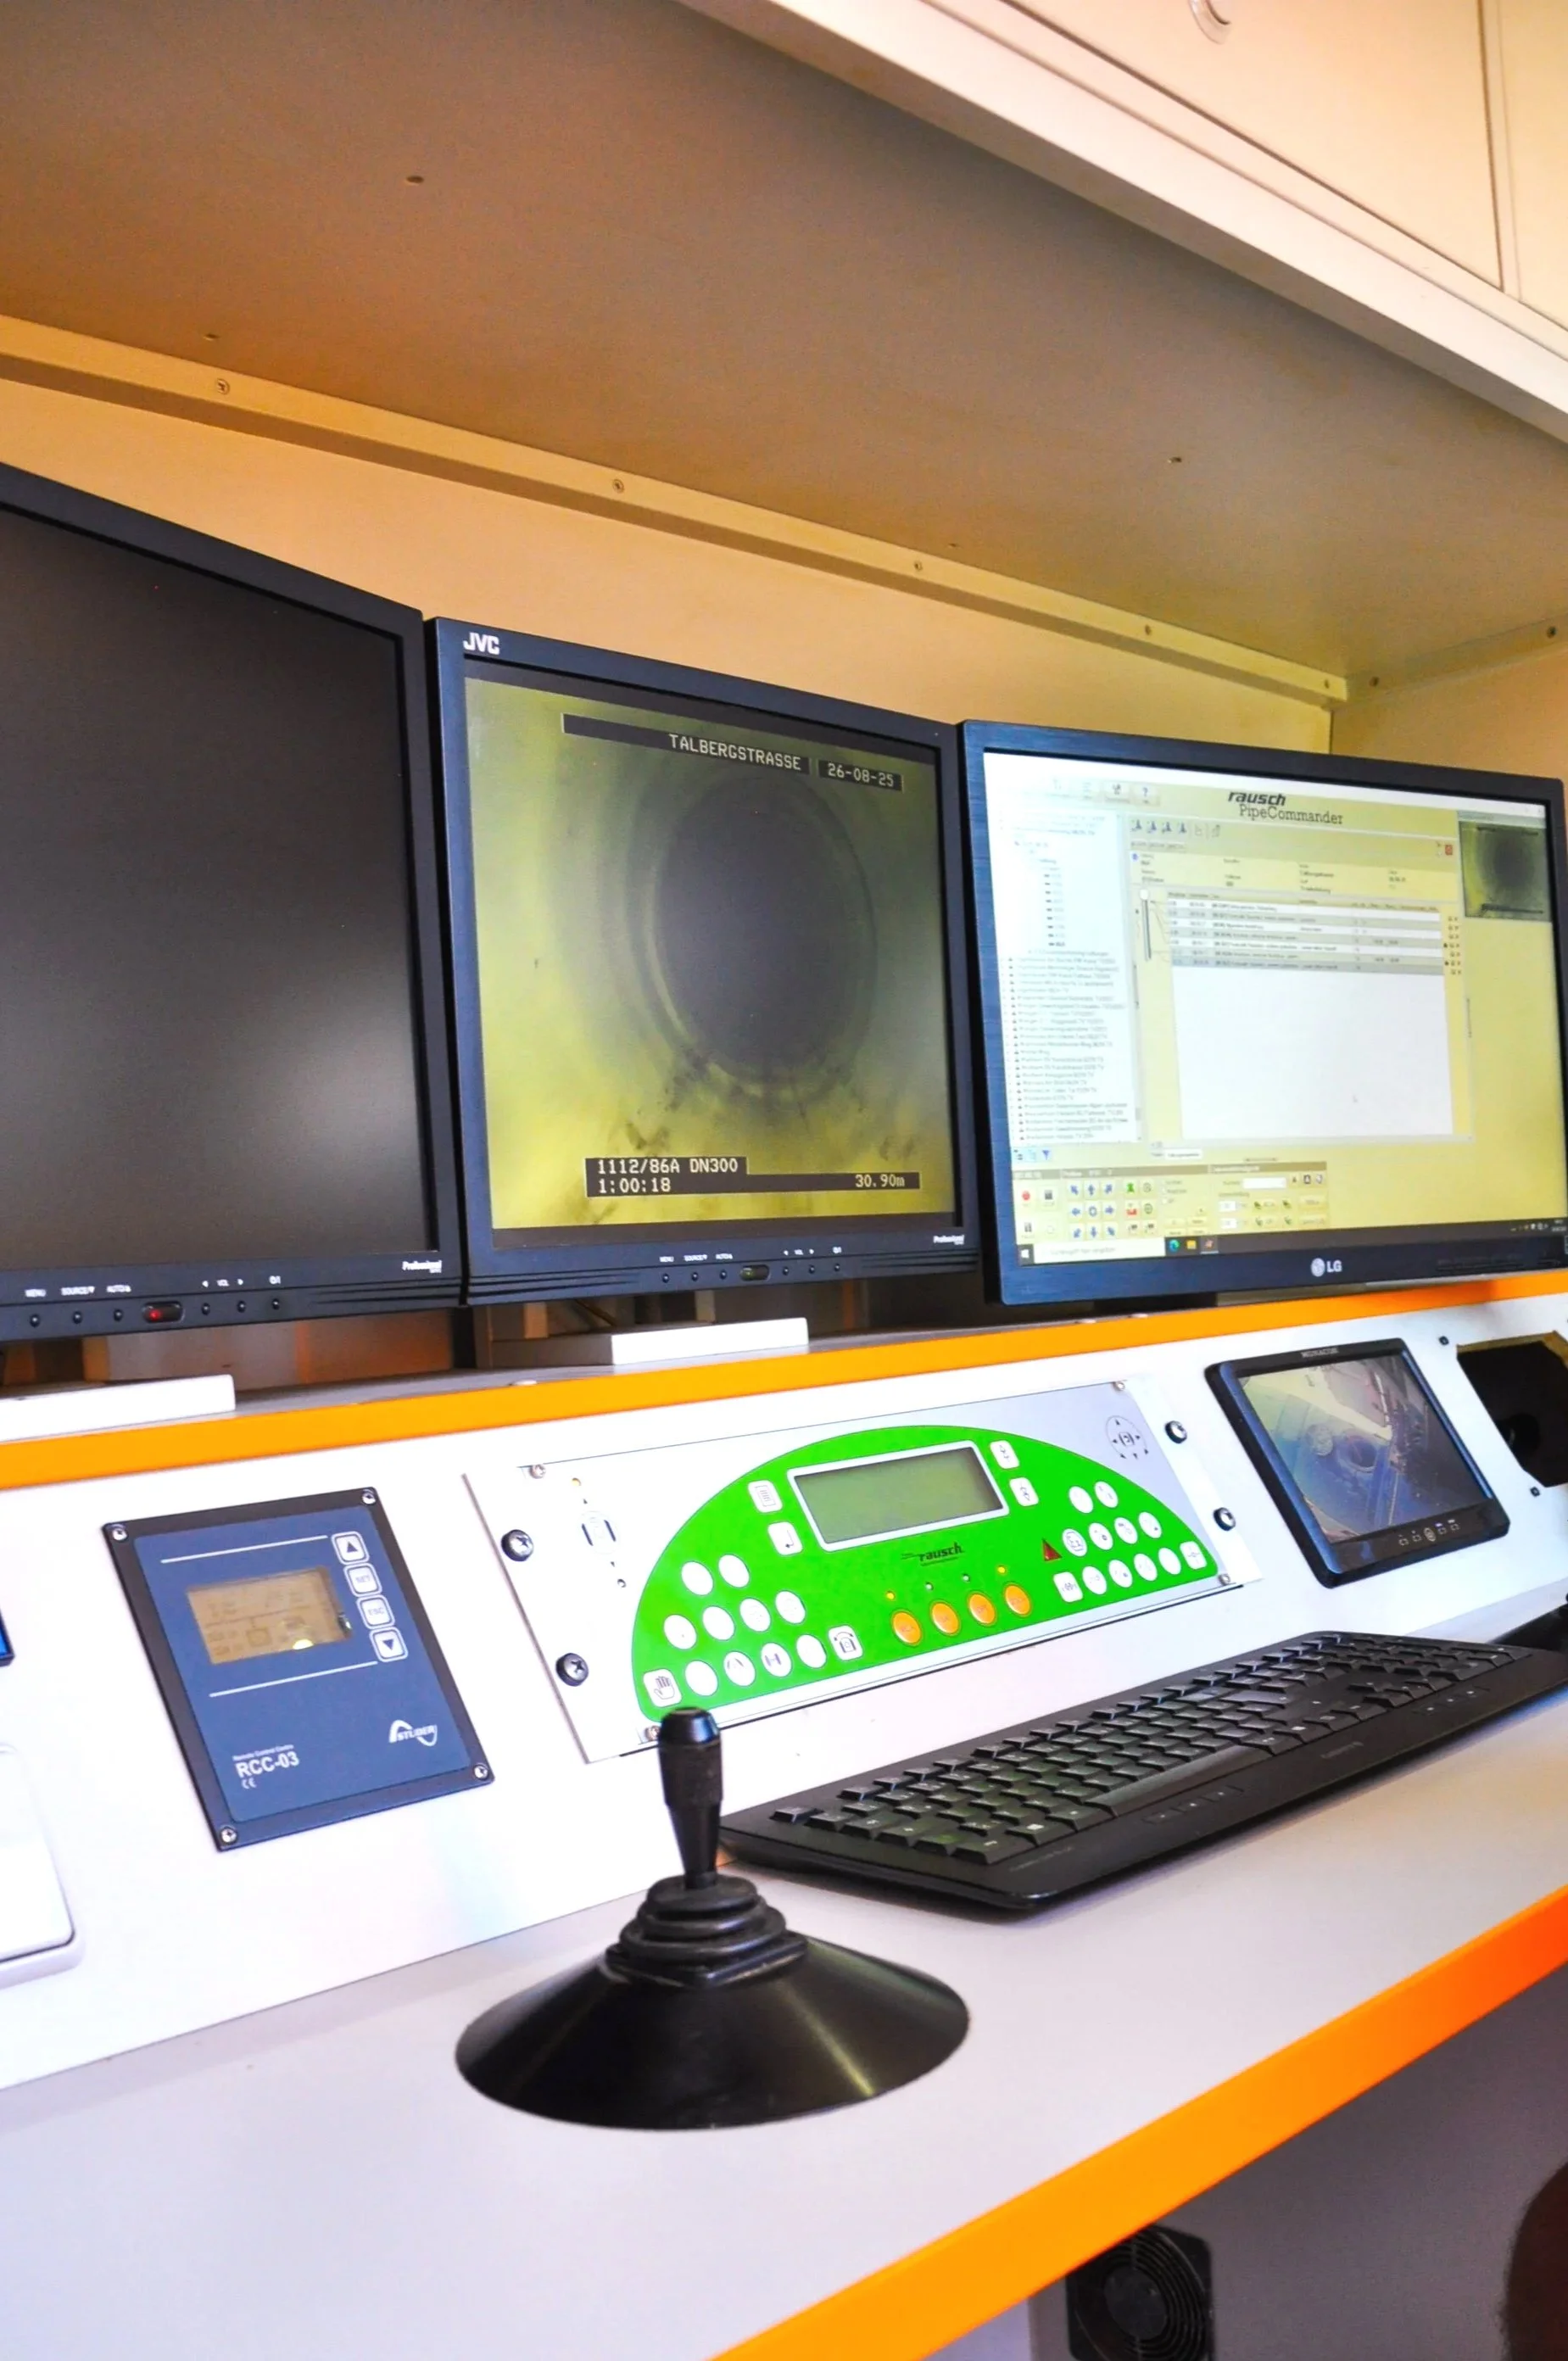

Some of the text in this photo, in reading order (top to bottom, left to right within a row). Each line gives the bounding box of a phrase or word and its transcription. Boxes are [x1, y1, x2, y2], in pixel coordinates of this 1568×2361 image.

[463, 632, 500, 655] JVC
[668, 733, 896, 788] TALBERGSTRASSE 26-08-25
[1228, 791, 1286, 807] rausch
[1239, 804, 1343, 825] PipeCommander
[597, 1158, 739, 1175] 1112/86A DN300
[598, 1174, 906, 1194] 1:00:18 30.90m
[1325, 1260, 1342, 1272] LG
[918, 1541, 964, 1562] rausch
[235, 1750, 300, 1779] RCC-03
